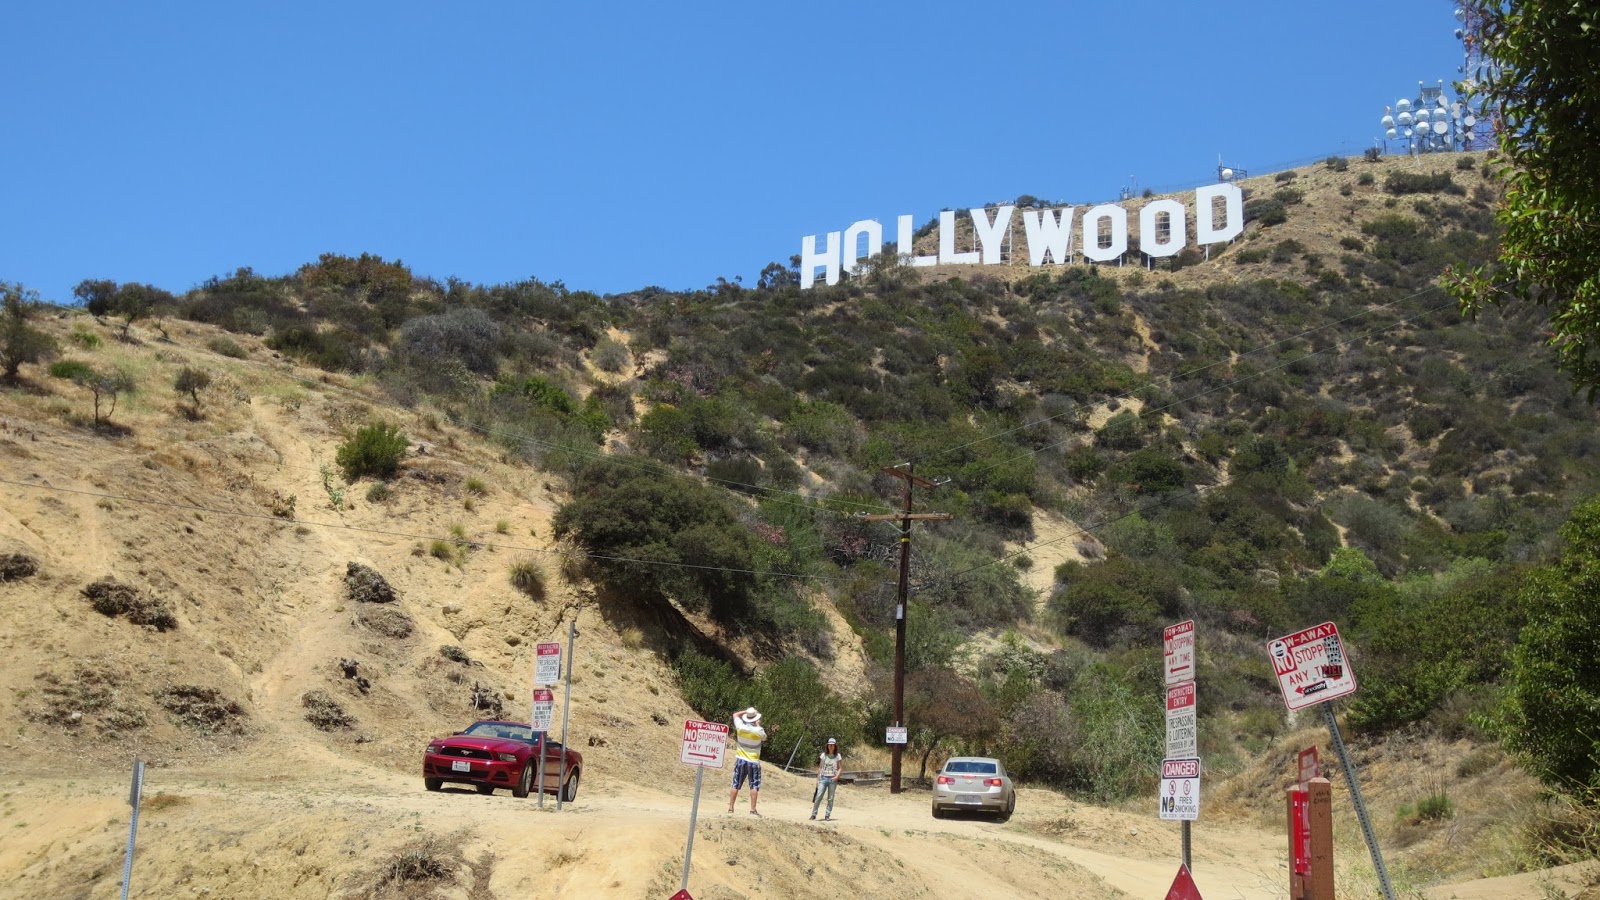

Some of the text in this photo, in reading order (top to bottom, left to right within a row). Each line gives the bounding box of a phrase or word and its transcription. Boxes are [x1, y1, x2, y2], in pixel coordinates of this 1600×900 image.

[800, 183, 1244, 290] HOLLYWOOD
[1165, 622, 1193, 637] TOW-AWAY
[1285, 624, 1332, 647] W-AWAY
[1275, 653, 1295, 674] NO
[1289, 670, 1309, 686] ANY
[1168, 685, 1194, 699] RESTRICTED
[1173, 696, 1187, 707] ENTRY
[688, 721, 726, 732] TOW-AWAY
[684, 729, 726, 744] NO STOPPING
[688, 743, 720, 755] ANY TIME
[1165, 762, 1196, 776] DANGER
[1162, 796, 1192, 813] NO FIRES
[1174, 805, 1197, 813] SMOKING
